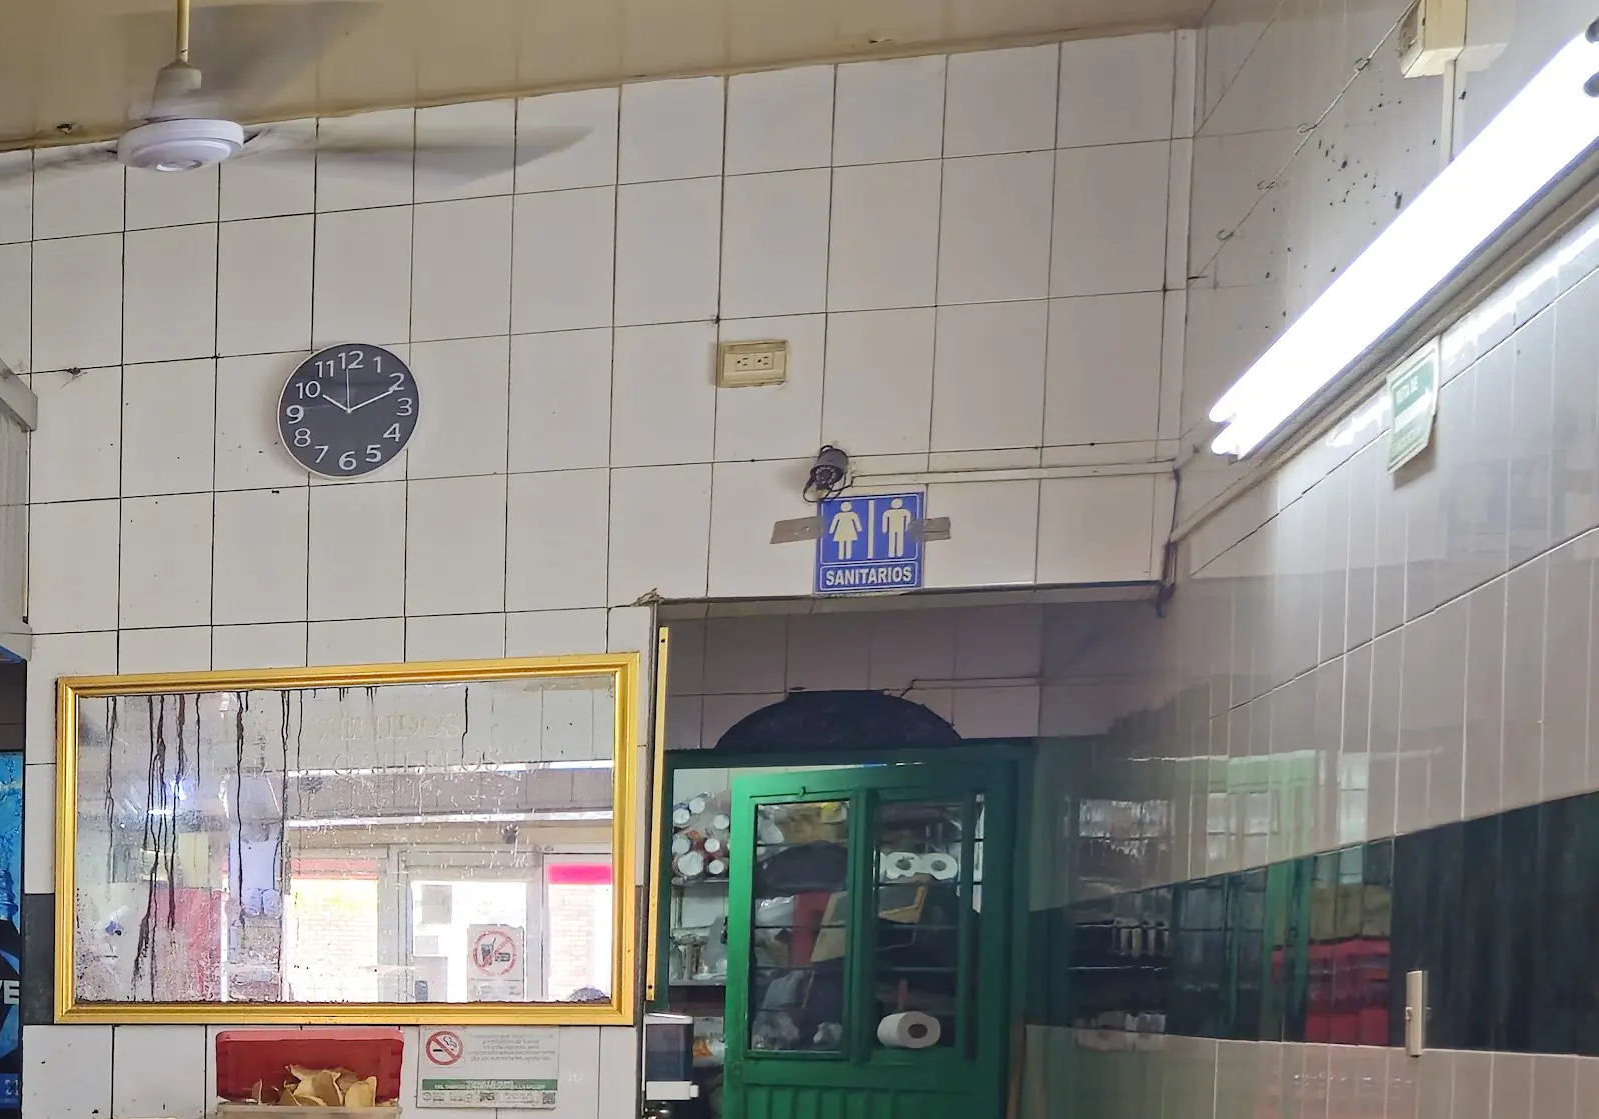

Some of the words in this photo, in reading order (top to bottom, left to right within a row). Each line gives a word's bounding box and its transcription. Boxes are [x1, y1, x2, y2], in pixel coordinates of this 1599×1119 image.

[314, 359, 334, 378] 11
[338, 350, 364, 369] 12
[372, 355, 381, 373] 1
[295, 380, 321, 400] 10
[389, 372, 405, 392] 2
[285, 404, 305, 424] 9
[395, 397, 413, 416] 3
[293, 427, 311, 447] 8
[382, 422, 401, 442] 4
[313, 444, 329, 463] 7
[338, 450, 357, 471] 6
[365, 444, 382, 463] 5
[825, 566, 913, 586] SANITARIOS
